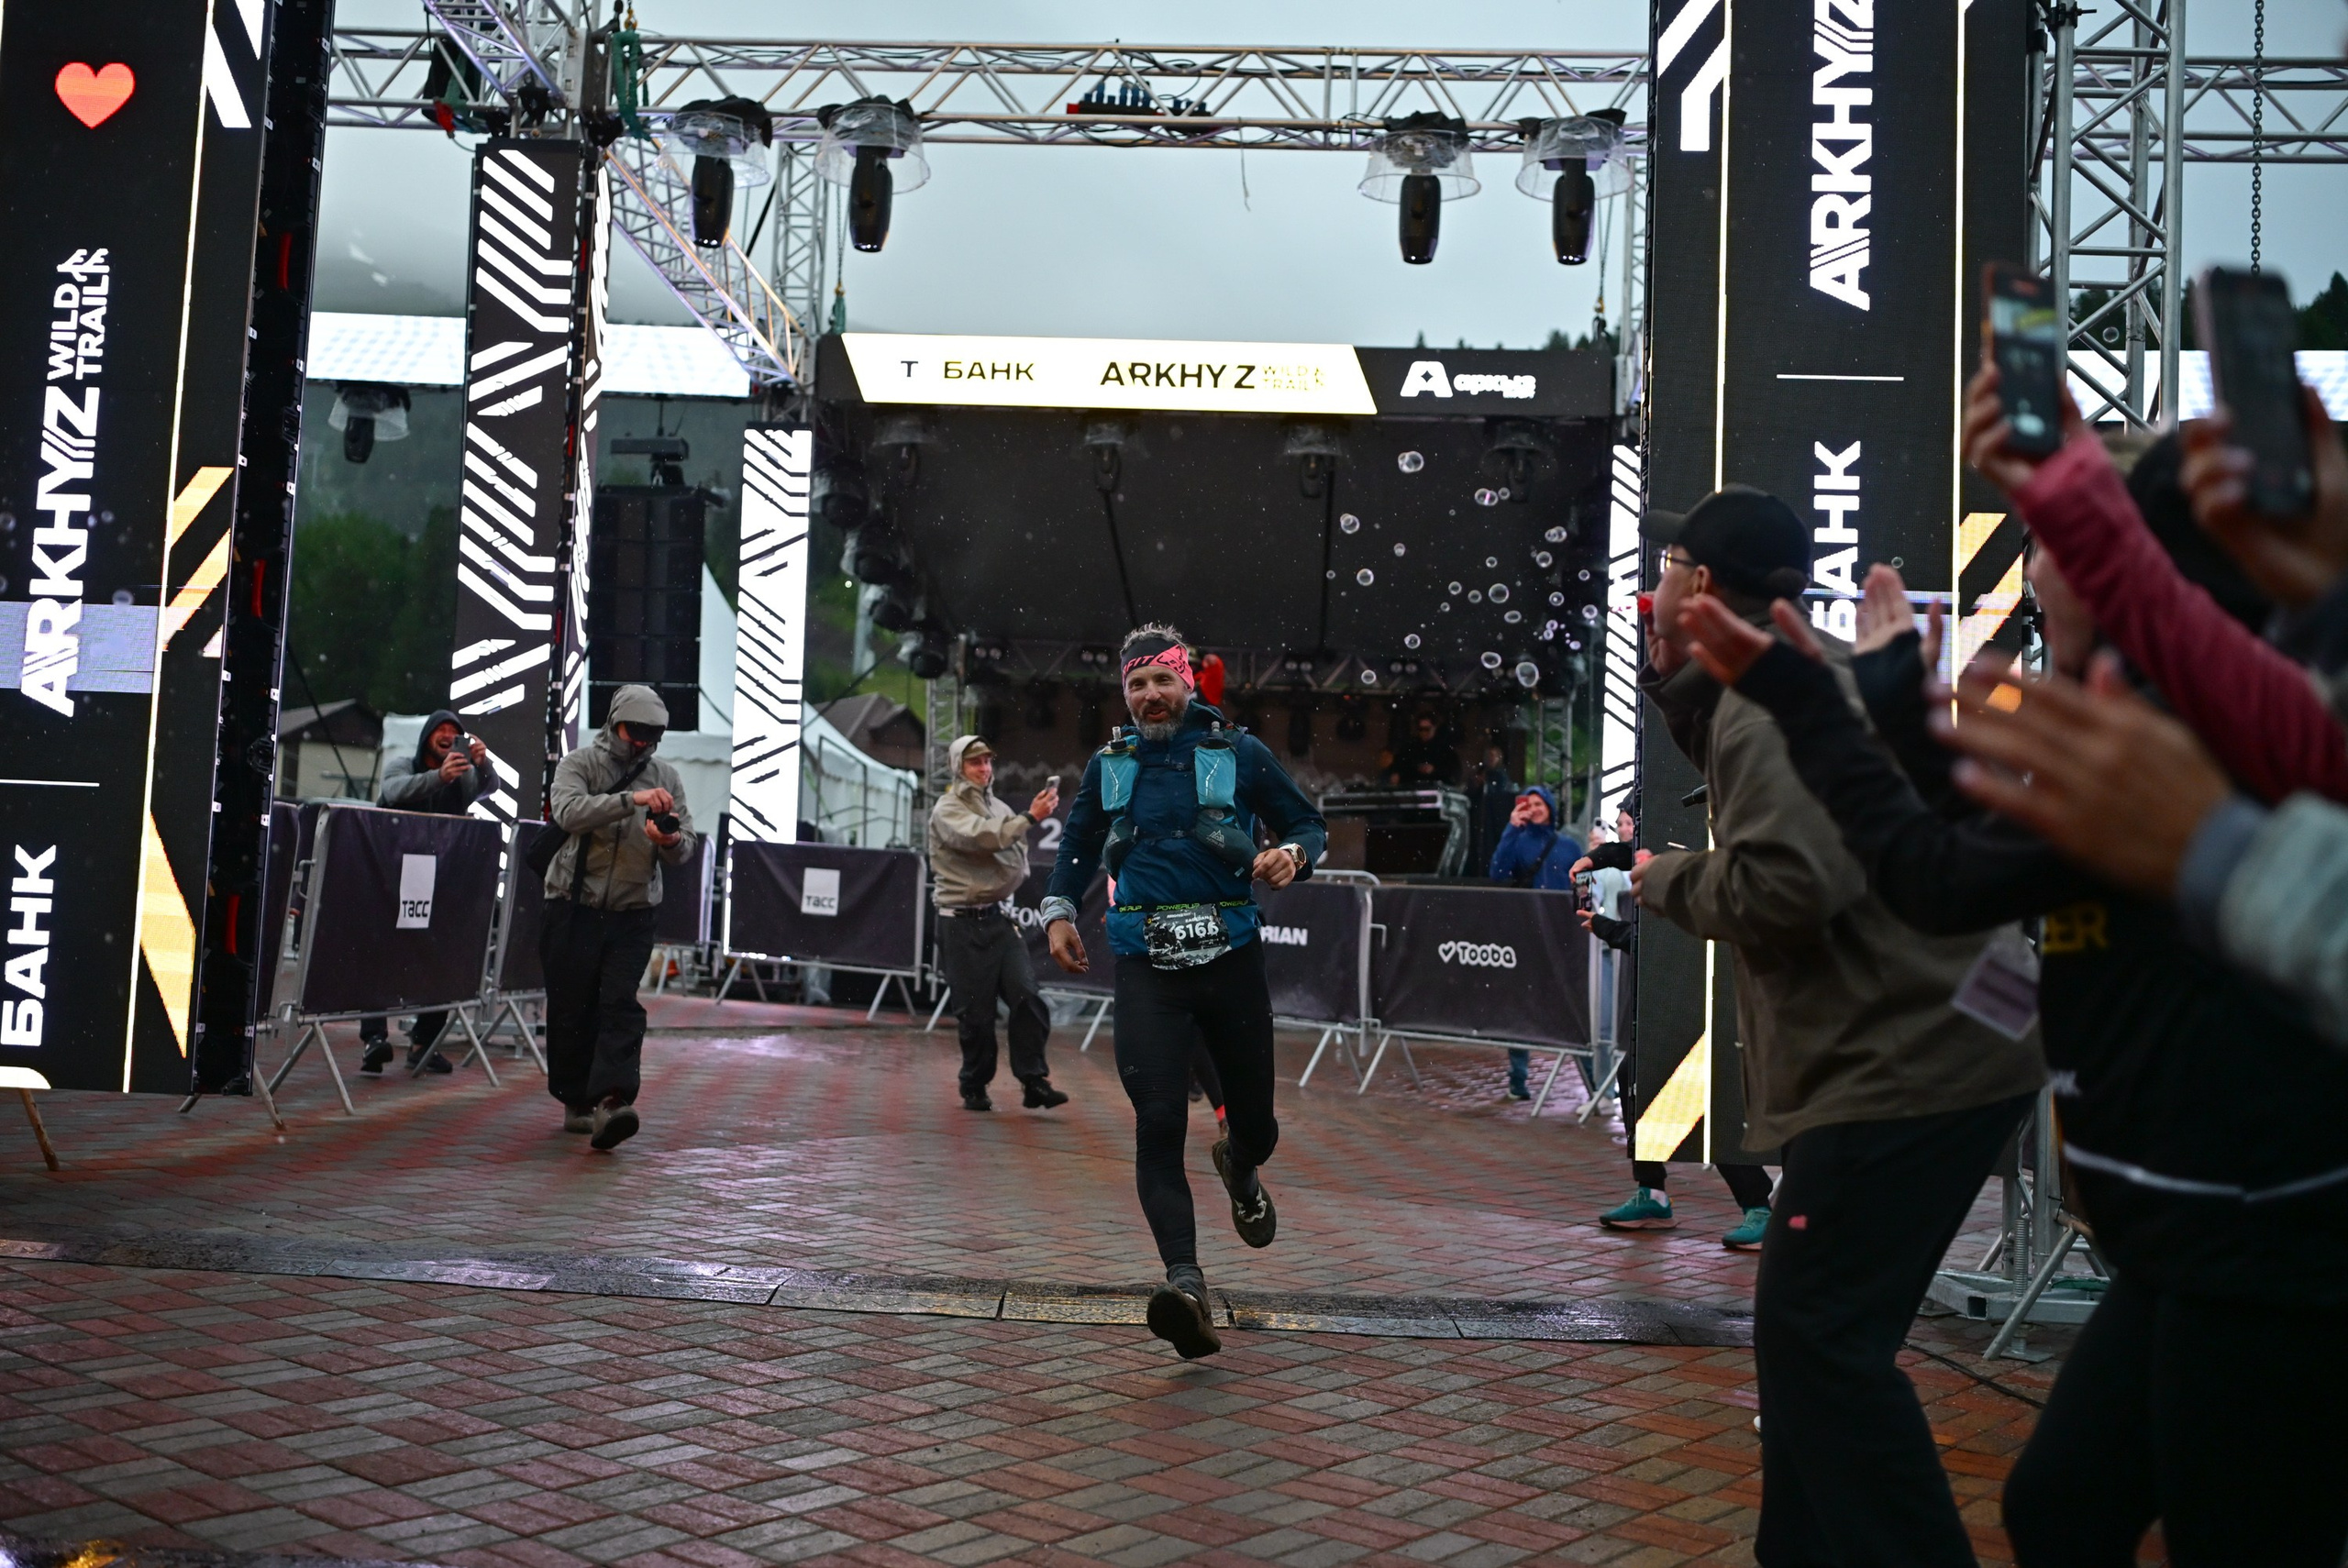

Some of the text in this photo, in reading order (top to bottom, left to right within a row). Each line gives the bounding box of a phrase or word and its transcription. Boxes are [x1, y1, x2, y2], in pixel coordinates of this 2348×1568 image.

[48, 282, 80, 380] WILD
[75, 274, 109, 380] TRAIL
[943, 360, 1035, 381] БАНК
[20, 385, 100, 718] ARKHYZ
[1812, 440, 1861, 643] БАНК
[0, 844, 57, 1047] БАНК
[1174, 922, 1220, 940] 6166
